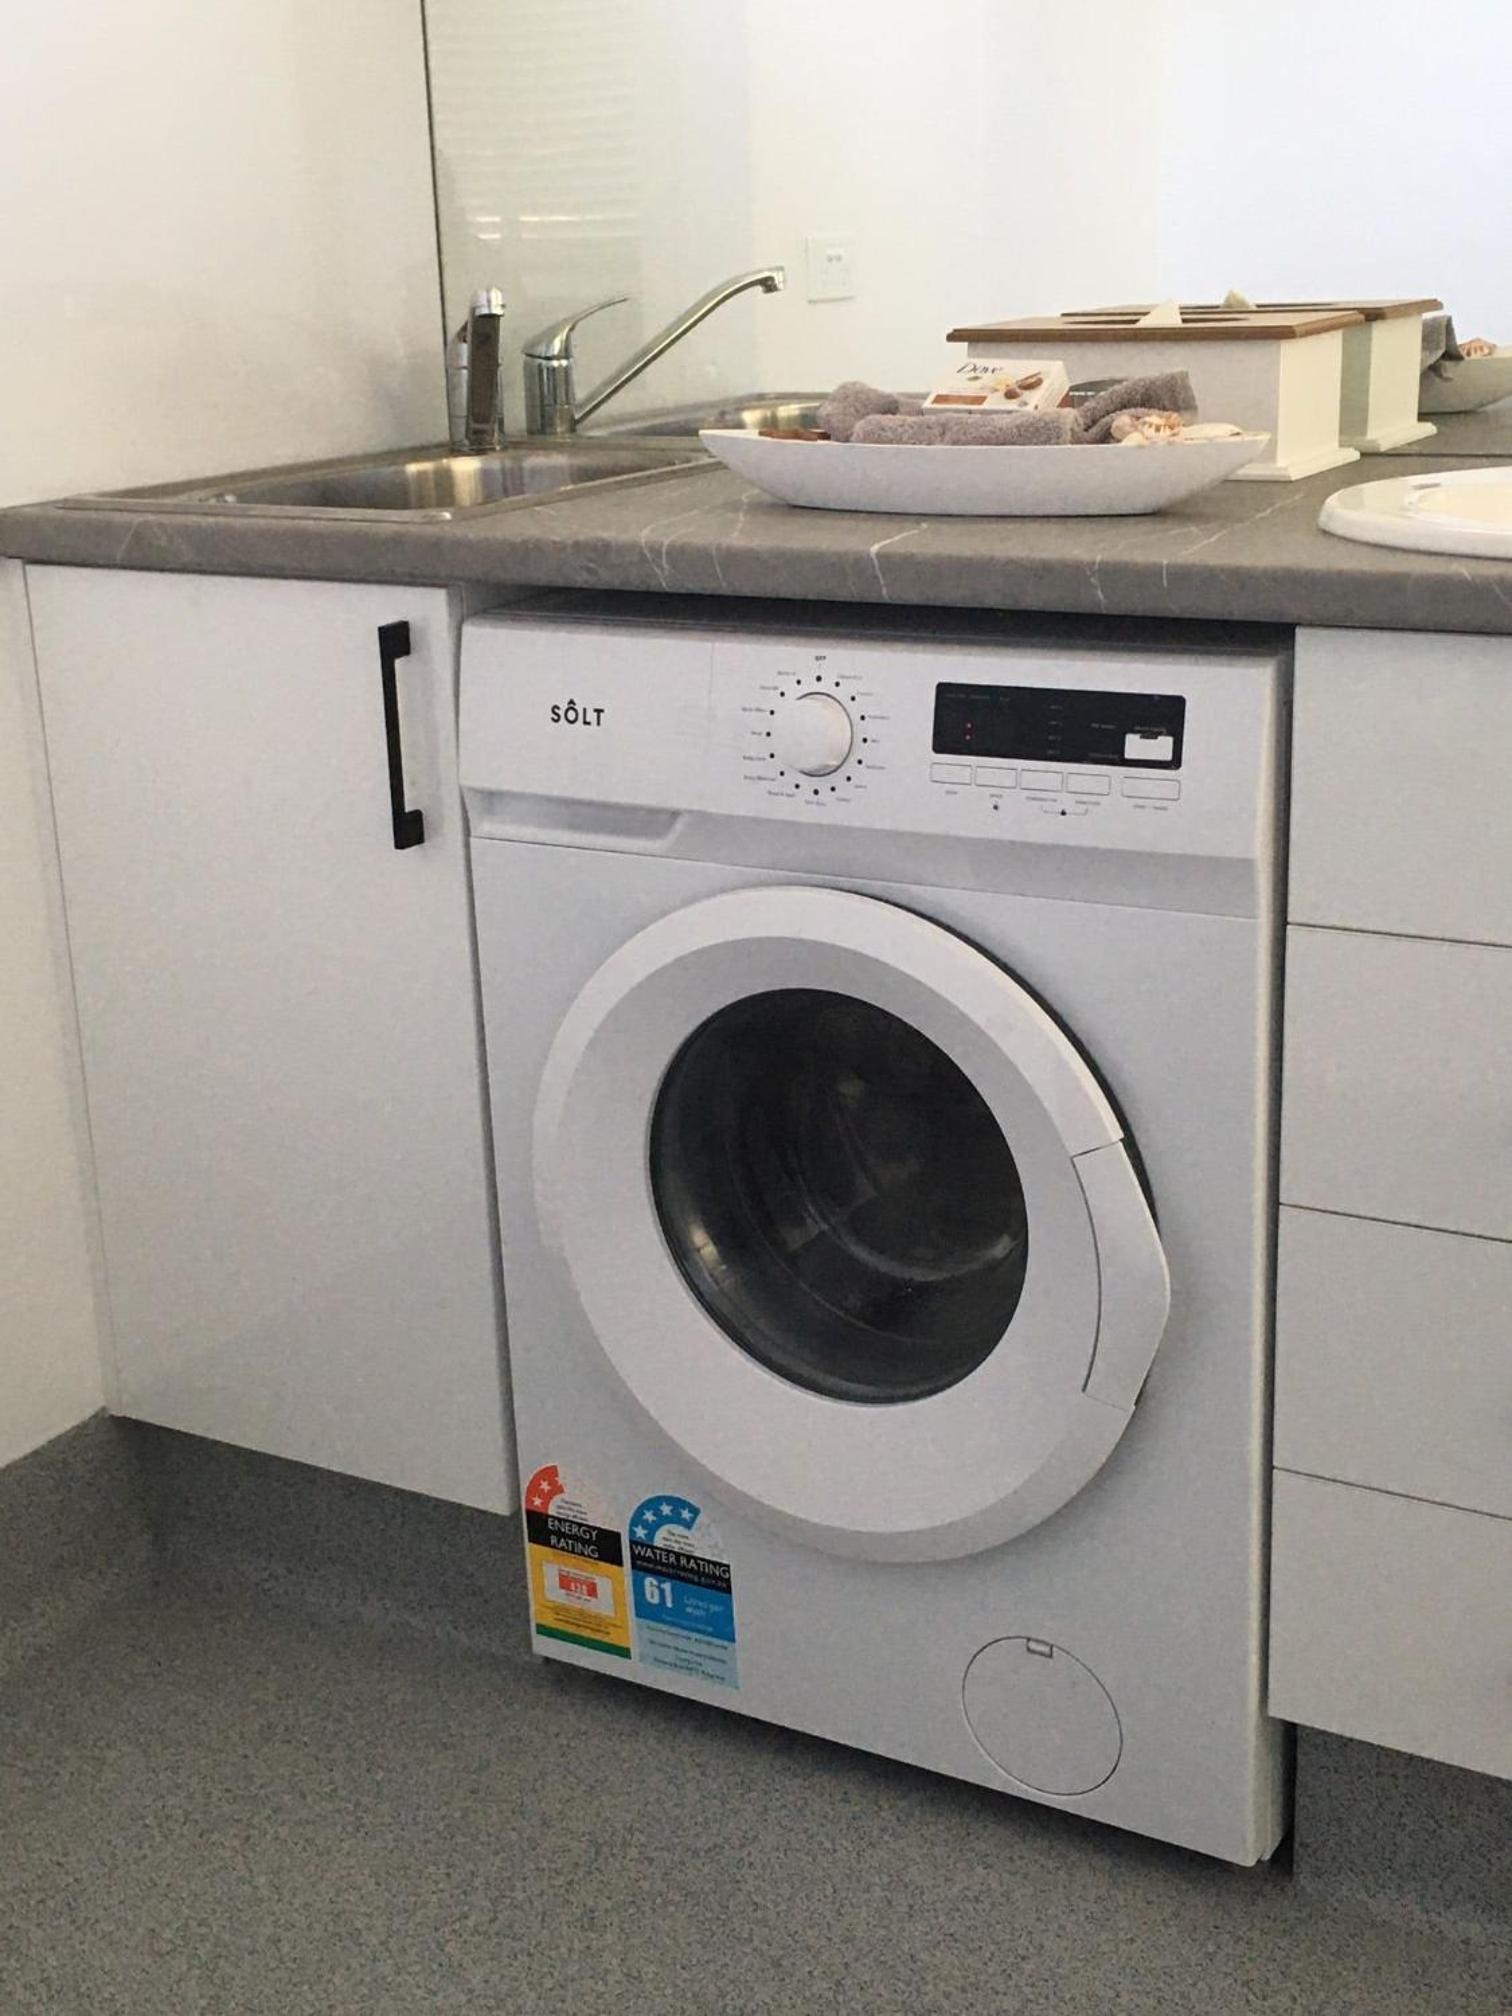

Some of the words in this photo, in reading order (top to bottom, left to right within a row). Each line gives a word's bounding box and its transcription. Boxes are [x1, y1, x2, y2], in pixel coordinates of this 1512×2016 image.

[550, 698, 605, 727] SÔLT
[547, 1517, 599, 1541] ENERGY
[550, 1536, 600, 1559] RATING
[633, 1544, 677, 1566] WATER
[680, 1555, 731, 1580] RATING
[644, 1577, 674, 1609] 61
